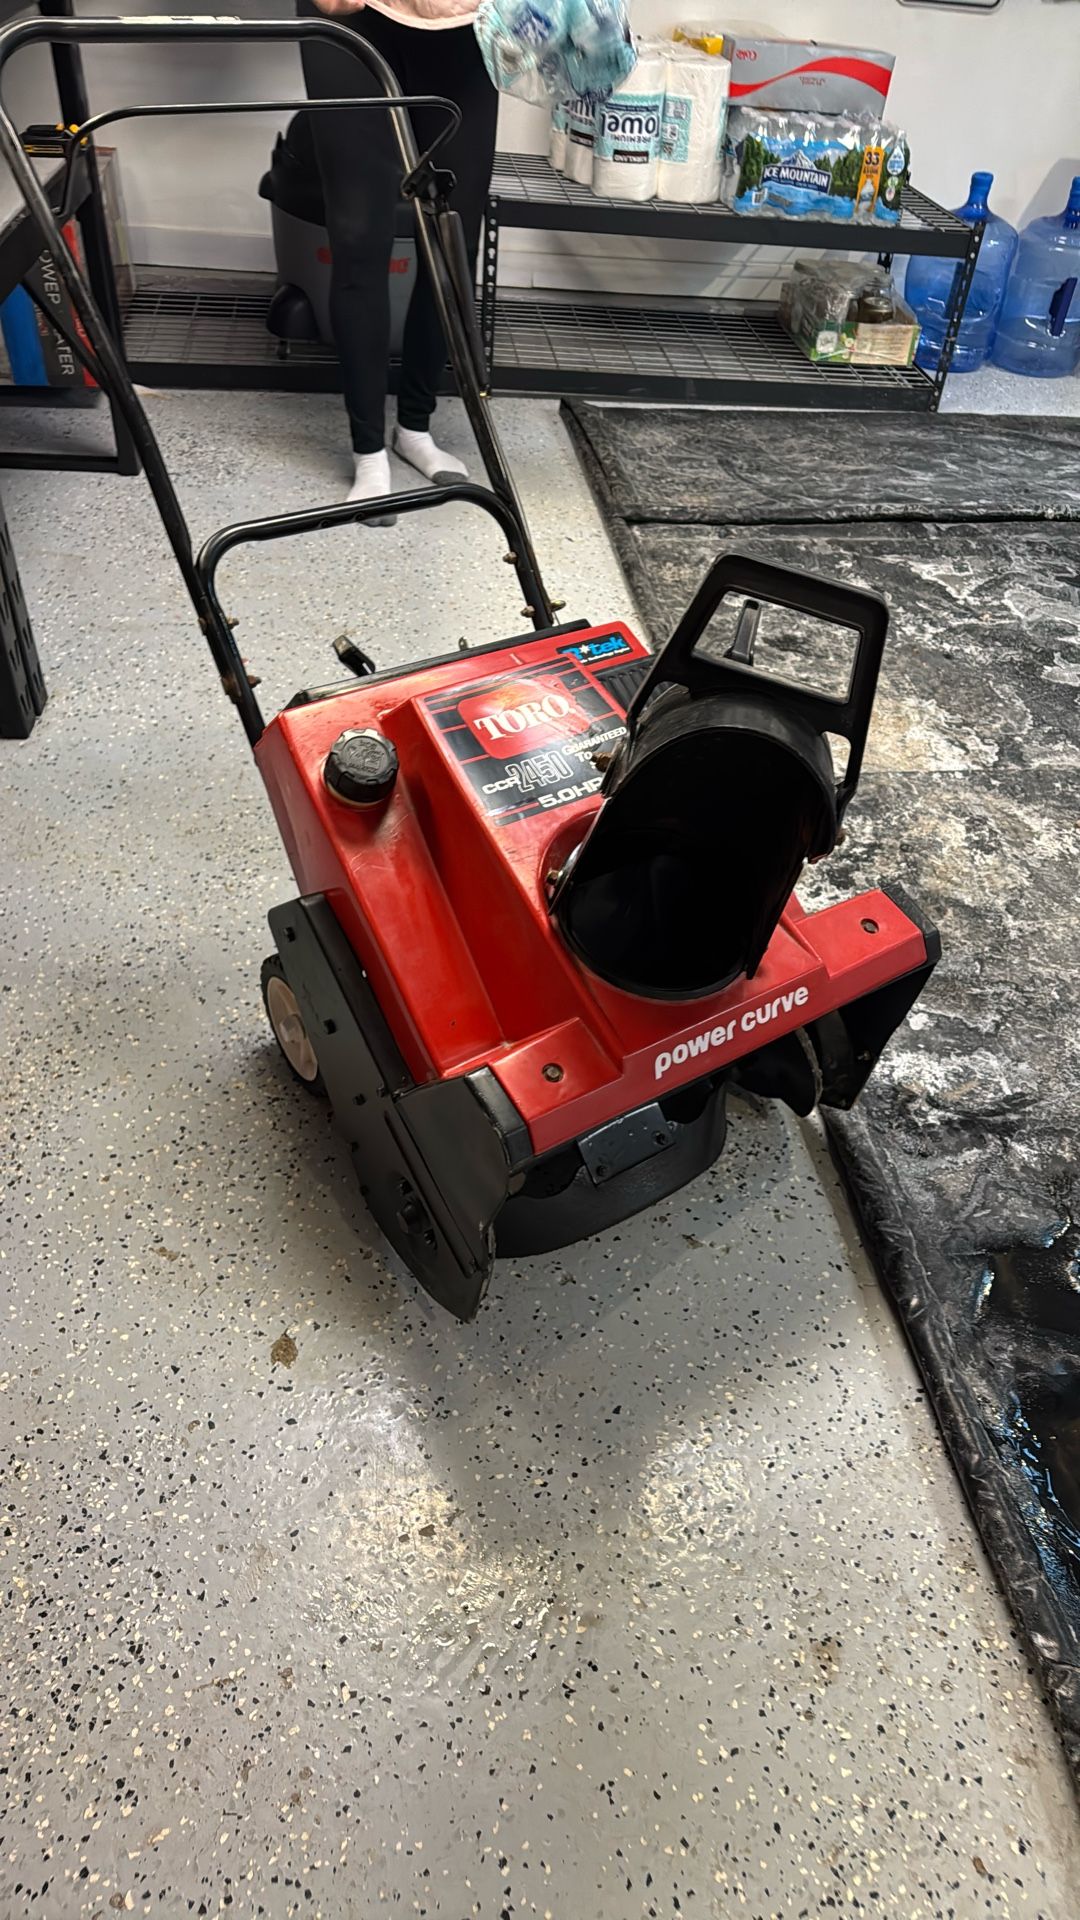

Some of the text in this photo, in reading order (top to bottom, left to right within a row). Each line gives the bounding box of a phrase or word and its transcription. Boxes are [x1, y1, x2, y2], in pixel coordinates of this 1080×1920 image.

[764, 167, 780, 178] ICE
[780, 166, 829, 187] MOUNTAIN
[561, 726, 627, 756] GUARANTEED
[482, 751, 574, 795] CCR 2450
[655, 986, 809, 1080] power curve
